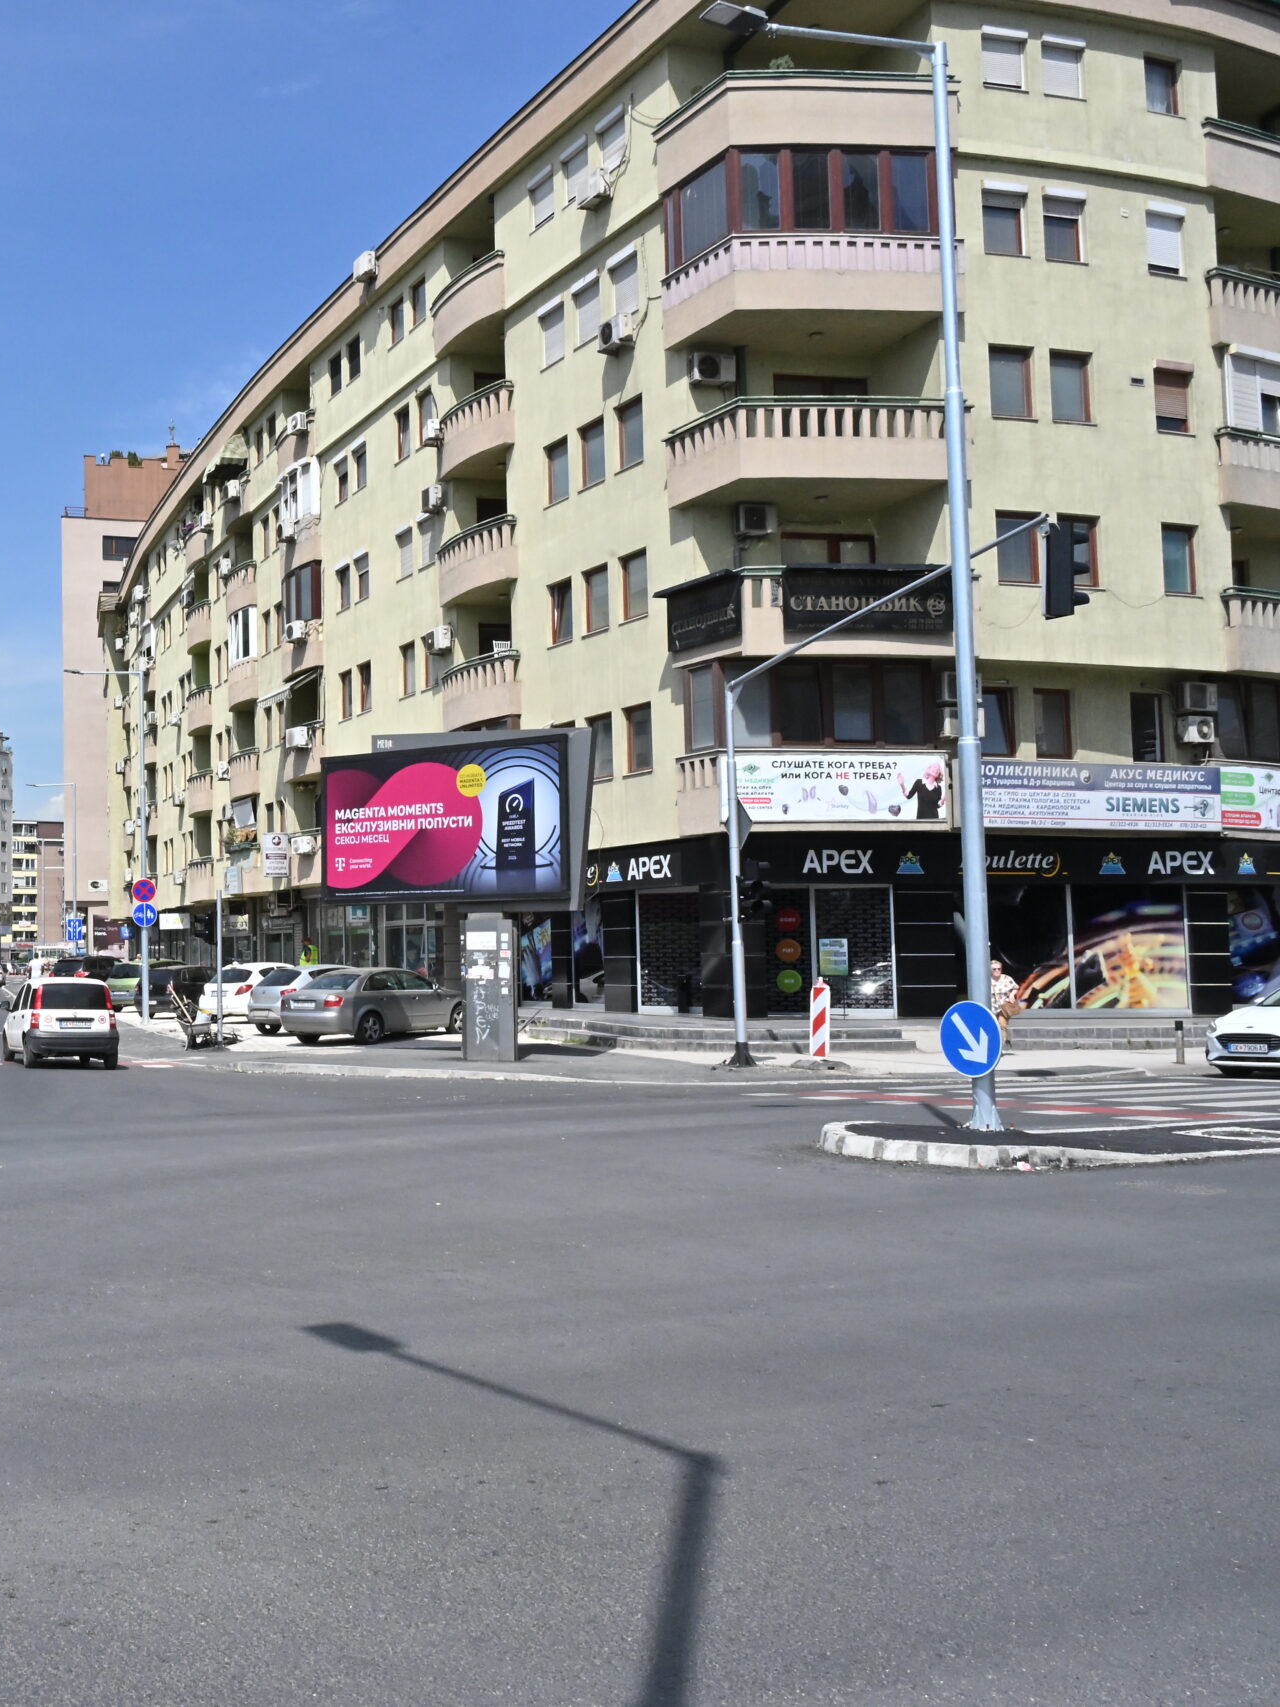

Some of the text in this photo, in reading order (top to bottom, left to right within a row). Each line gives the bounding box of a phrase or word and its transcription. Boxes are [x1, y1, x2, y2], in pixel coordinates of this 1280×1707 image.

[771, 760, 898, 770] СЛУШАТЕ КОГА ТРЕБА?
[781, 772, 892, 780] или КОГА НЕ ТРЕБА?
[1110, 769, 1206, 782] АКУС МЕДИКУС
[1104, 781, 1125, 789] Центар
[335, 802, 444, 821] MAGENTA MOMENTS
[1105, 796, 1180, 814] SIEMENS
[335, 815, 473, 834] ЕКСКЛУЗИВНИ ПОПУСТИ
[335, 834, 390, 845] СЕКОЈ МЕСЕЦ
[627, 854, 672, 881] APEX
[802, 849, 874, 874] APEX
[960, 850, 1054, 869] oulette
[1147, 850, 1215, 875] APEX
